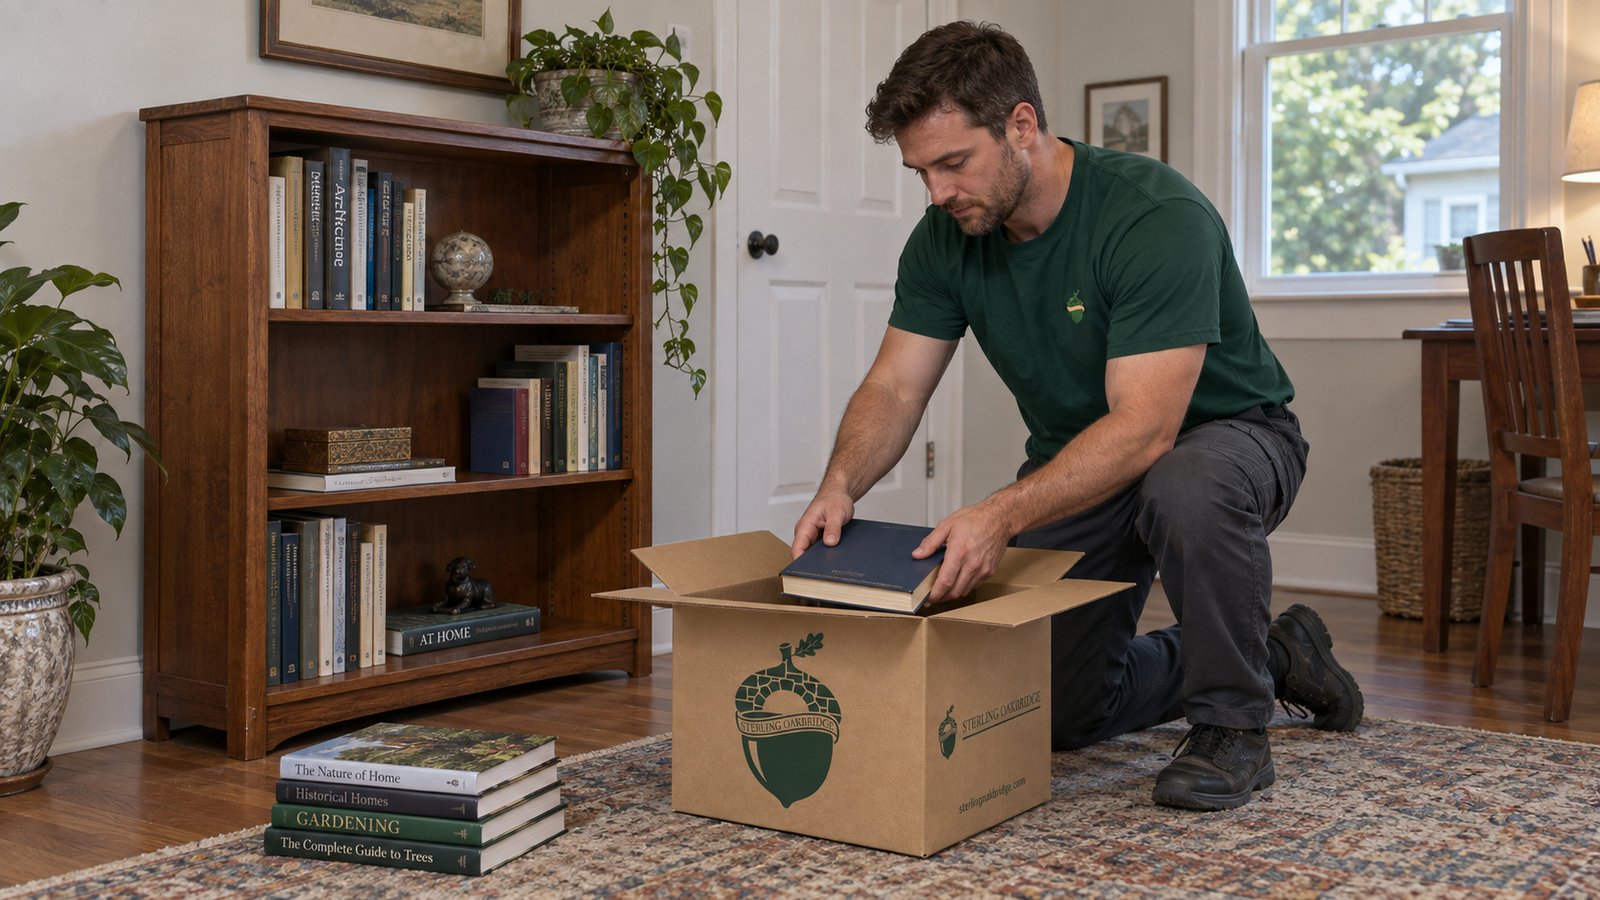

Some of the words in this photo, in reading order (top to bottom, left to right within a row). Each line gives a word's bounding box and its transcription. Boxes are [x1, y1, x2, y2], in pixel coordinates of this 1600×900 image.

[420, 633, 434, 646] AT
[437, 626, 471, 643] HOME
[740, 720, 782, 733] STERLING
[962, 707, 999, 733] STERLING
[295, 763, 315, 776] The
[317, 765, 352, 779] Nature
[354, 767, 367, 780] of
[369, 770, 401, 784] Home
[296, 787, 348, 803] Historical
[351, 792, 389, 807] Homes
[296, 811, 400, 834] GARDENING
[280, 836, 300, 849] The
[302, 839, 353, 855] Complete
[355, 844, 387, 858] Guide
[390, 847, 401, 860] to
[403, 848, 434, 863] Trees
